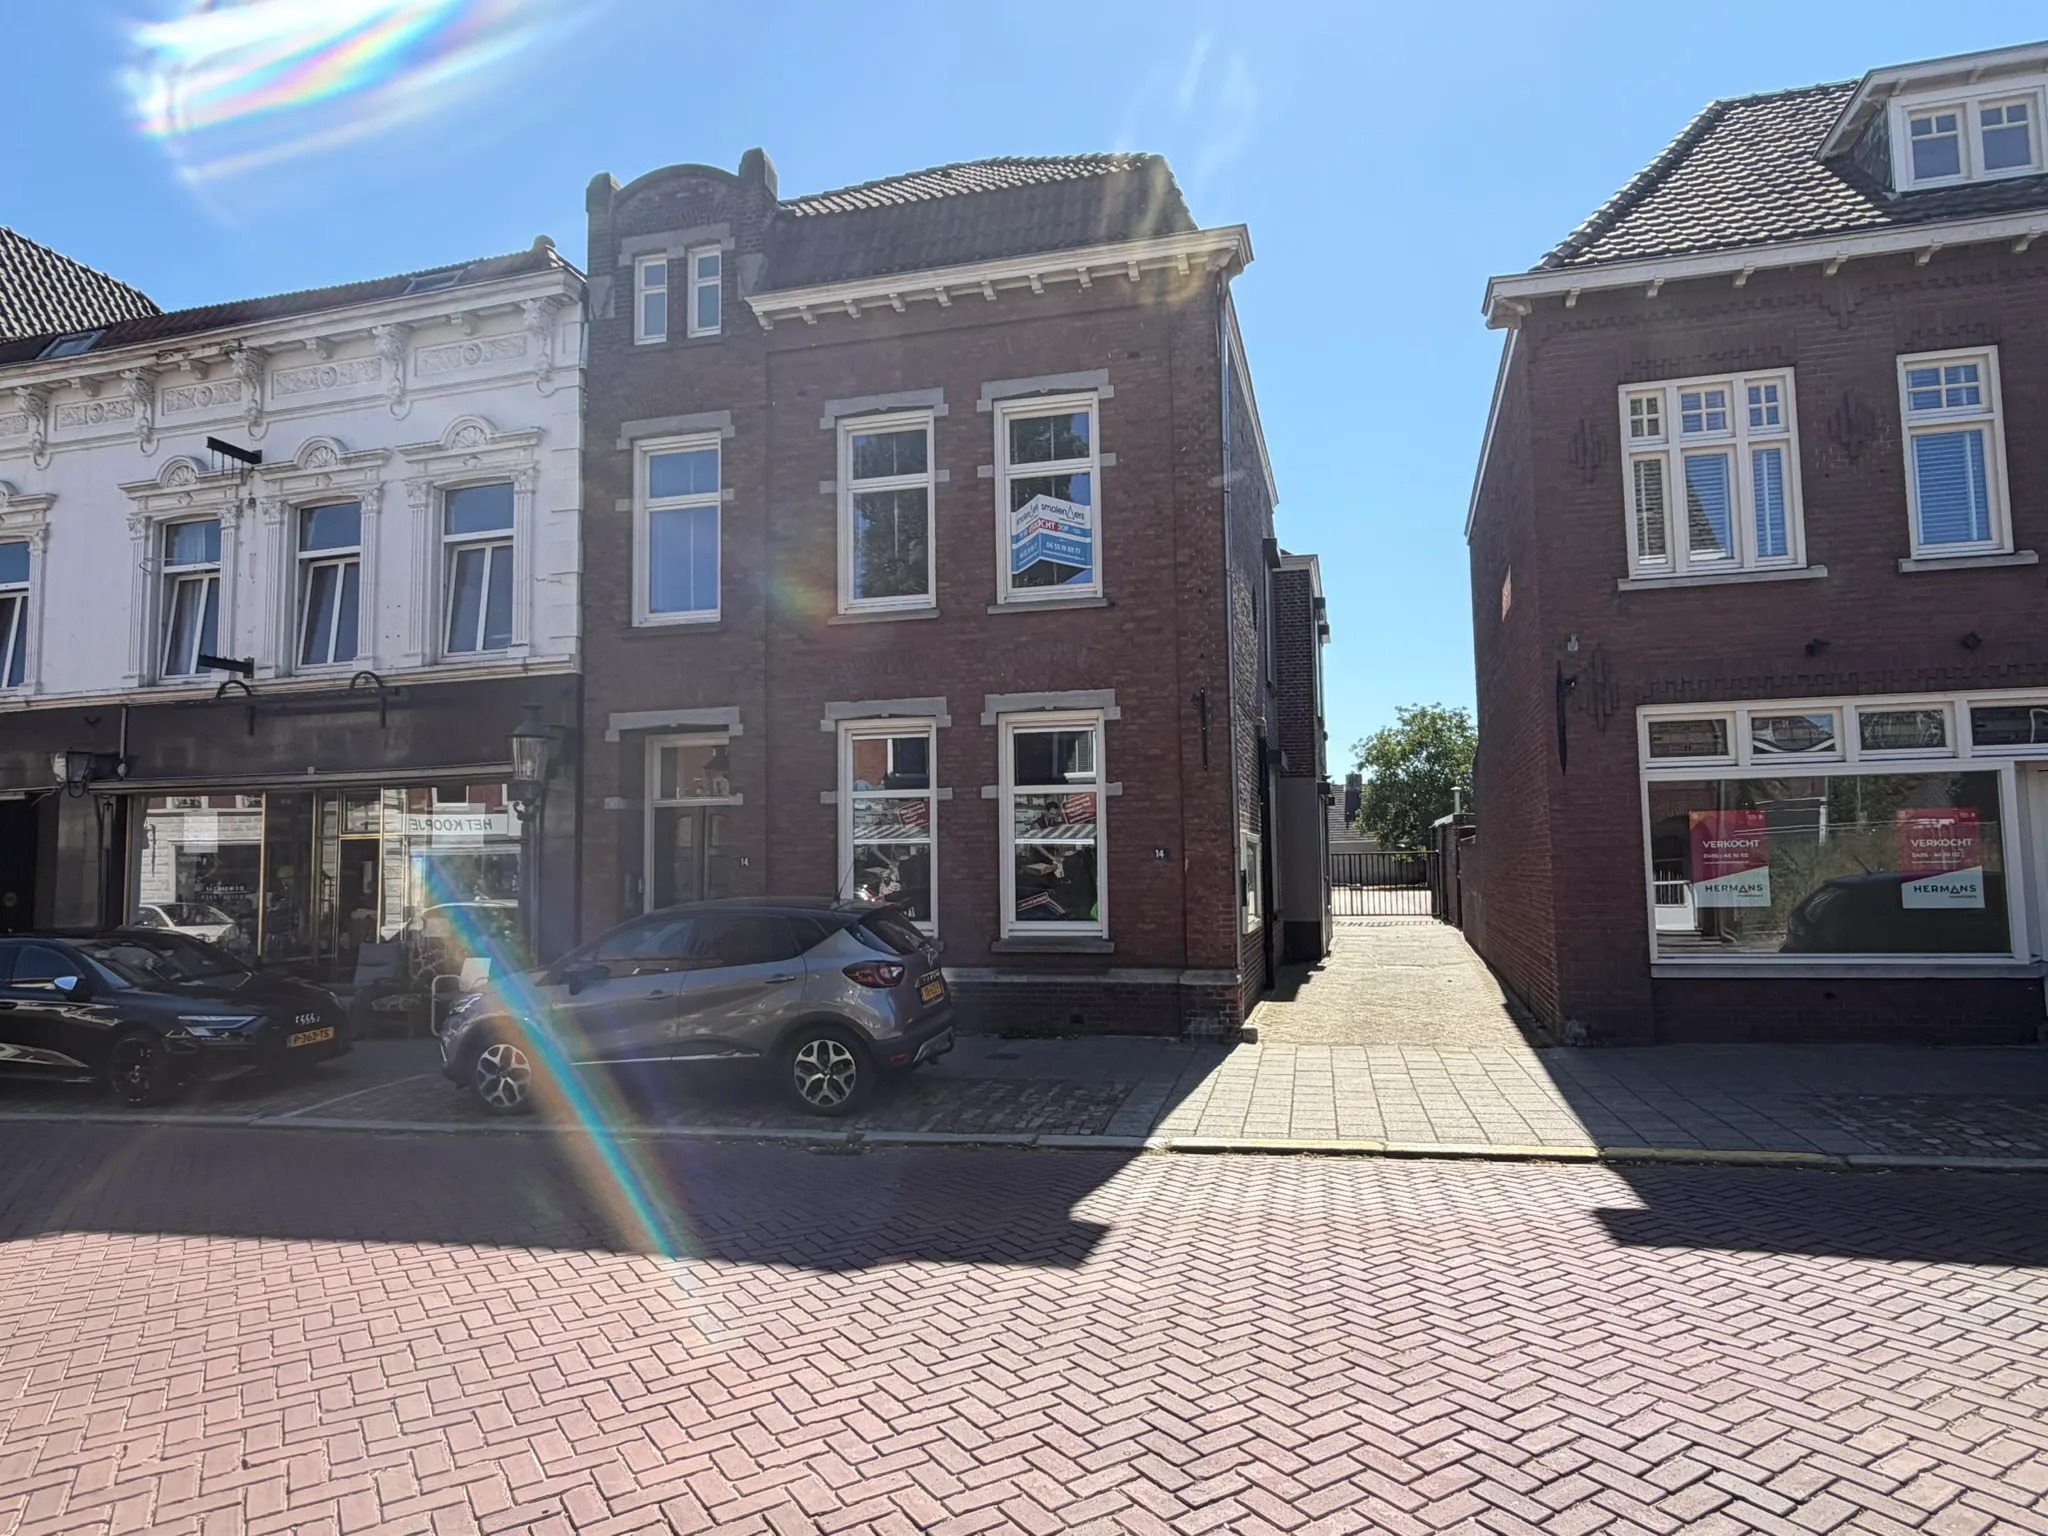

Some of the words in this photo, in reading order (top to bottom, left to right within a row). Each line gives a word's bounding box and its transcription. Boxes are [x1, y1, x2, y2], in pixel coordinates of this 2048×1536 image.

[1702, 839, 1760, 849] VERKOCHT
[1910, 838, 1973, 847] VERKOCHT
[1155, 849, 1164, 858] 14
[1705, 884, 1764, 893] HERMANS
[1914, 884, 1977, 894] HERMANS
